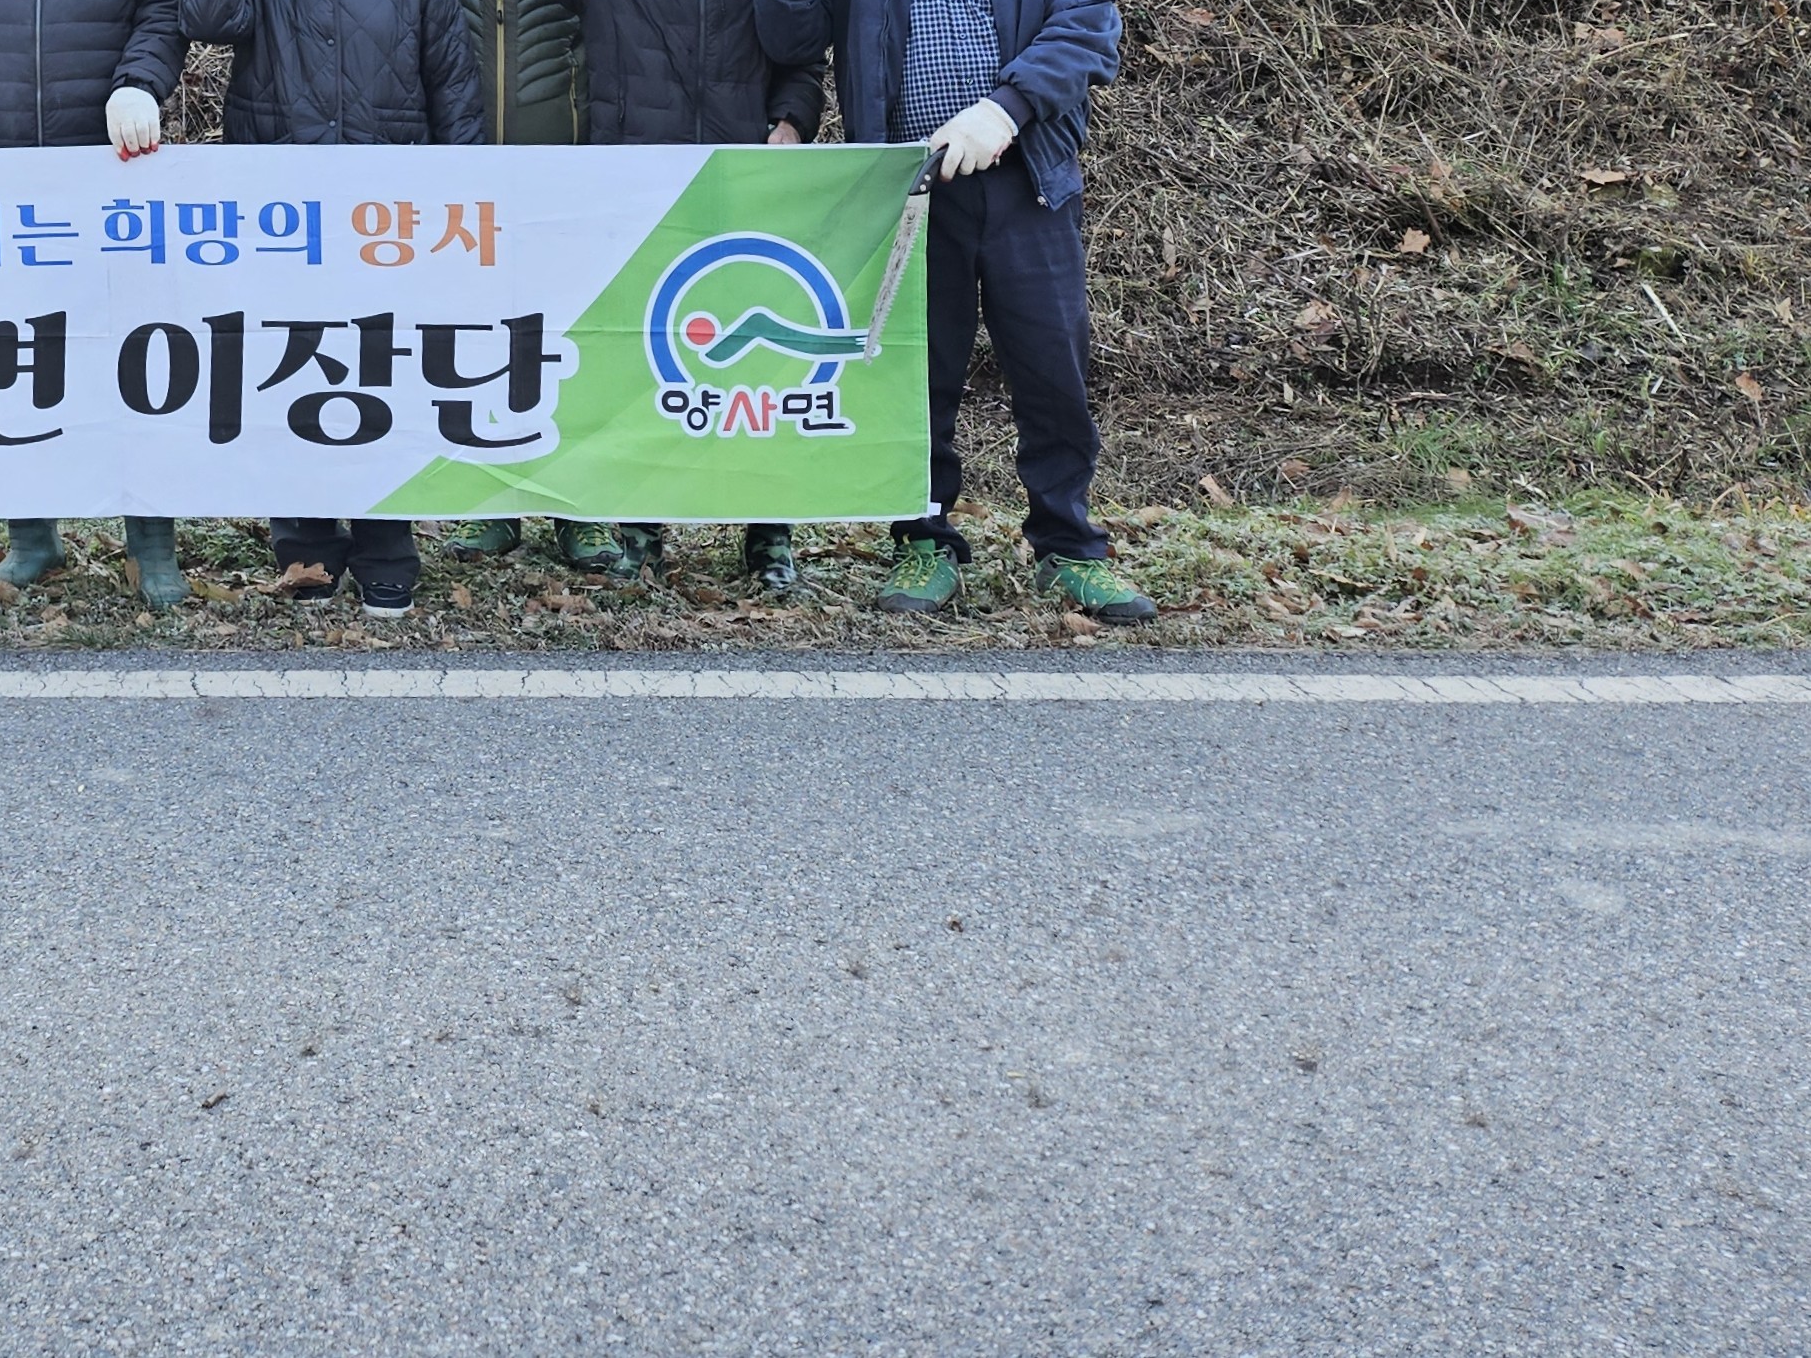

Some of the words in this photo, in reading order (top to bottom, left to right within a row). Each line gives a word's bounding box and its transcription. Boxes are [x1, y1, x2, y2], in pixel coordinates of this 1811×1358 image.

[101, 198, 322, 266] 희망의
[351, 201, 502, 266] 양사
[117, 311, 561, 448] 이장단
[661, 390, 849, 431] 양사면
